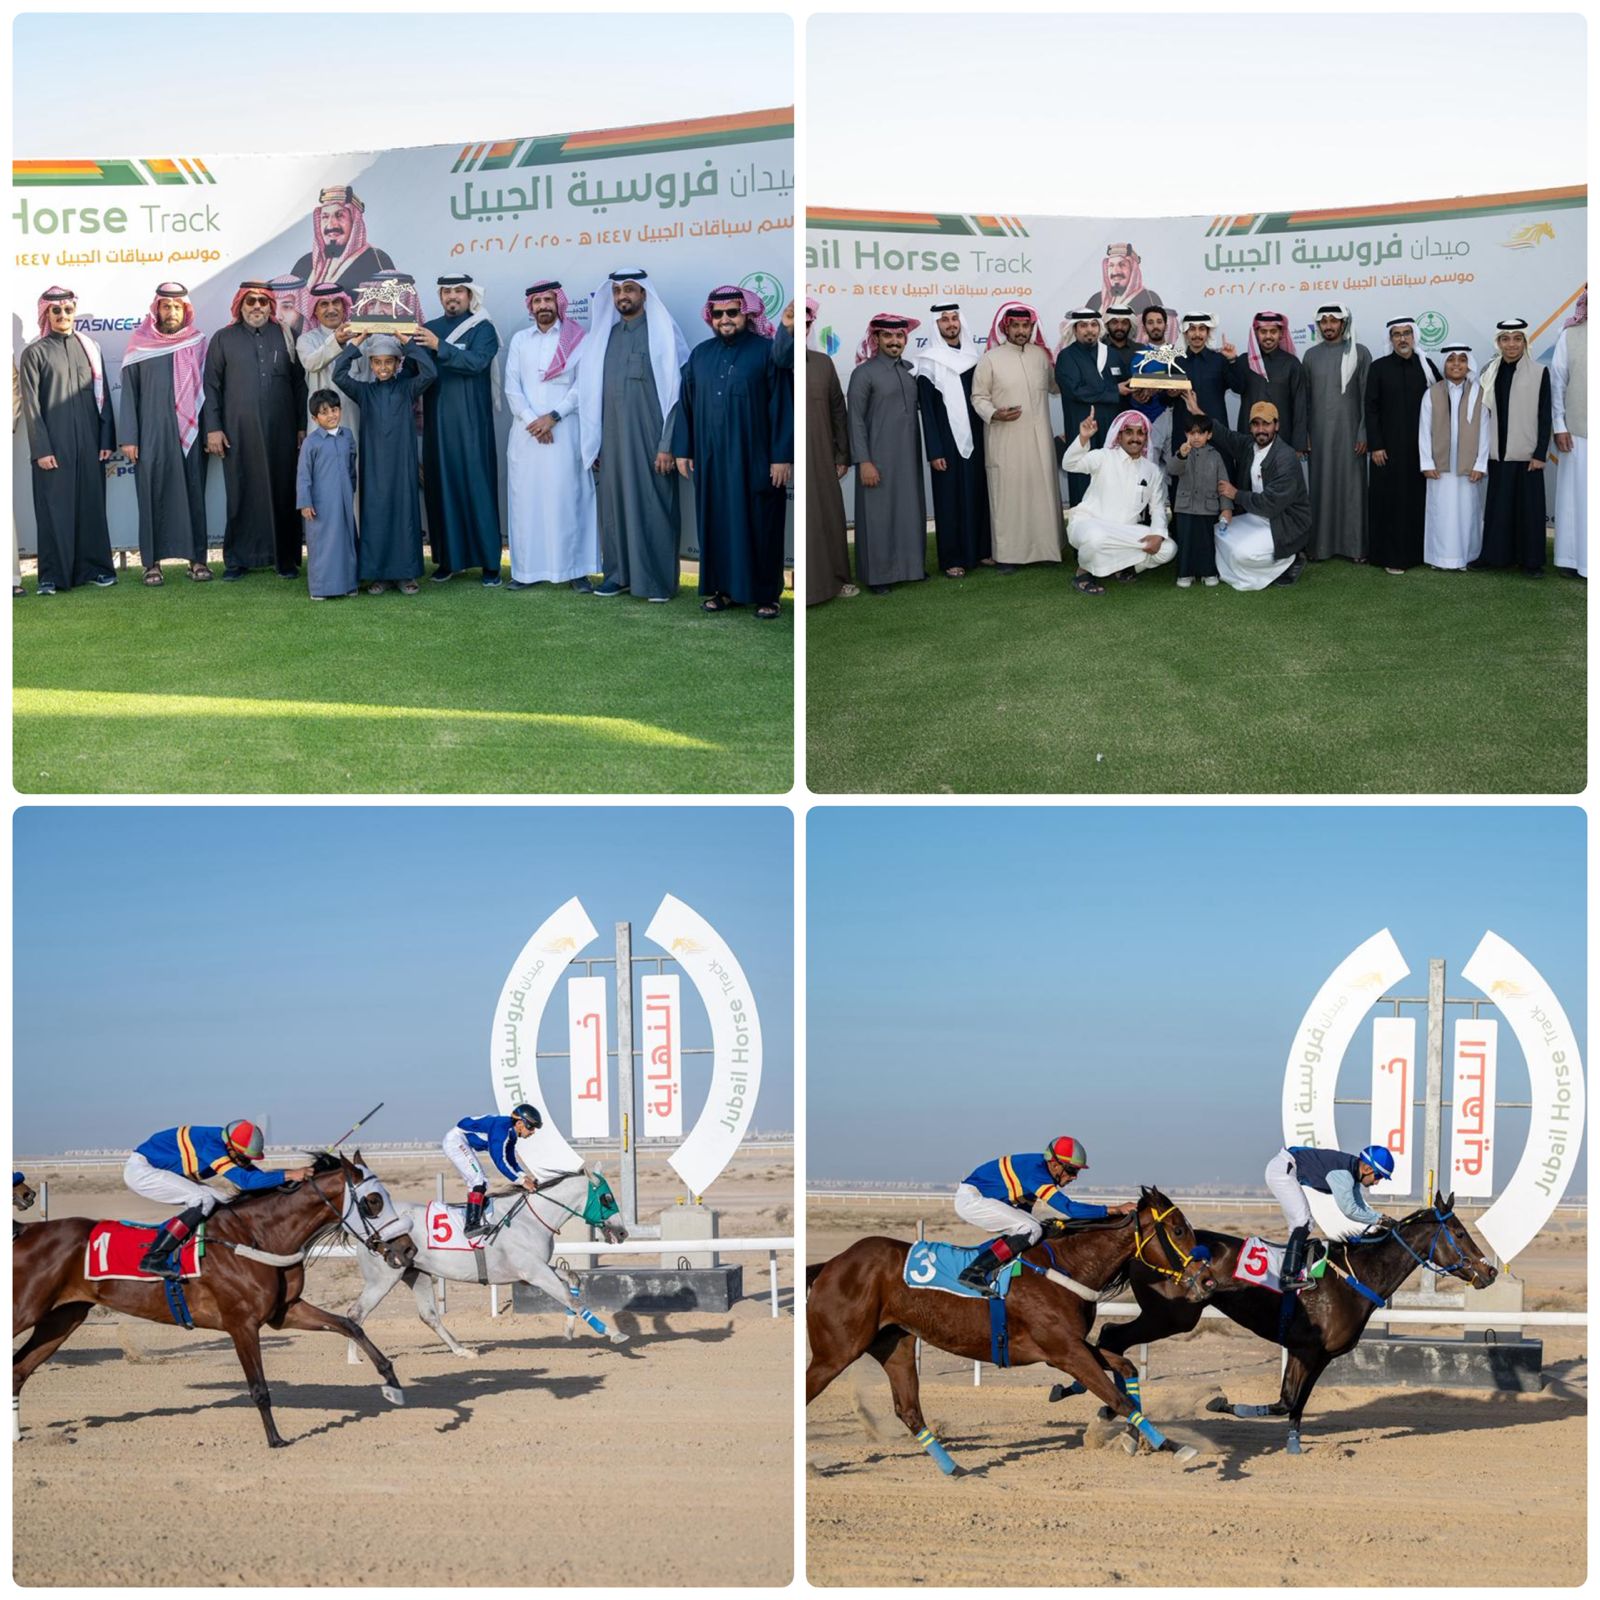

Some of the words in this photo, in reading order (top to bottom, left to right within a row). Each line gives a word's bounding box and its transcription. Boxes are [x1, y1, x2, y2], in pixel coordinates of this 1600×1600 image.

[567, 159, 718, 214] فروسية
[730, 162, 794, 198] يدان
[450, 175, 553, 222] الجبيل
[140, 204, 221, 233] Track
[637, 222, 684, 243] الجبيل
[689, 218, 752, 238] سباقات
[470, 239, 504, 252] ٢٠٢٦
[525, 235, 560, 249] ٢٠٢٥
[597, 230, 631, 244] ١٤٤٧
[1292, 232, 1402, 268] فروسية
[1411, 235, 1470, 261] ميدان
[15, 253, 50, 266] ١٤٤٧
[56, 250, 101, 267] الجبيل
[106, 248, 163, 266] سباقات
[168, 248, 221, 264] موسم
[854, 240, 960, 272] Horse
[970, 250, 1033, 274] Track
[1204, 240, 1281, 273] الجبيل
[868, 286, 898, 297] ١٤٤٧
[902, 283, 939, 298] الجبيل
[942, 283, 988, 298] سباقات
[991, 283, 1033, 298] موسم
[1219, 284, 1245, 295] ٢٠٢٦
[1260, 282, 1286, 294] ٢٠٢٥
[1313, 280, 1339, 291] ١٤٤٧
[1342, 275, 1377, 291] الجبيل
[1380, 274, 1427, 289] سباقات
[1429, 271, 1475, 286] موسم
[519, 958, 545, 991] ميدان
[707, 958, 735, 996] Track
[501, 990, 526, 1069] فروسية
[730, 998, 750, 1064] Horse
[1530, 1005, 1558, 1046] Track
[576, 1012, 602, 1102] خط
[645, 993, 679, 1118] النهاية
[1294, 1027, 1324, 1114] فروسية
[1551, 1050, 1571, 1121] Horse
[720, 1070, 748, 1134] Jubail
[1455, 1040, 1490, 1176] النهاية
[1534, 1129, 1568, 1197] Jubail
[432, 1213, 453, 1243] 5
[93, 1231, 111, 1272] 1
[909, 1249, 938, 1284] 3
[1243, 1246, 1268, 1276] 5
